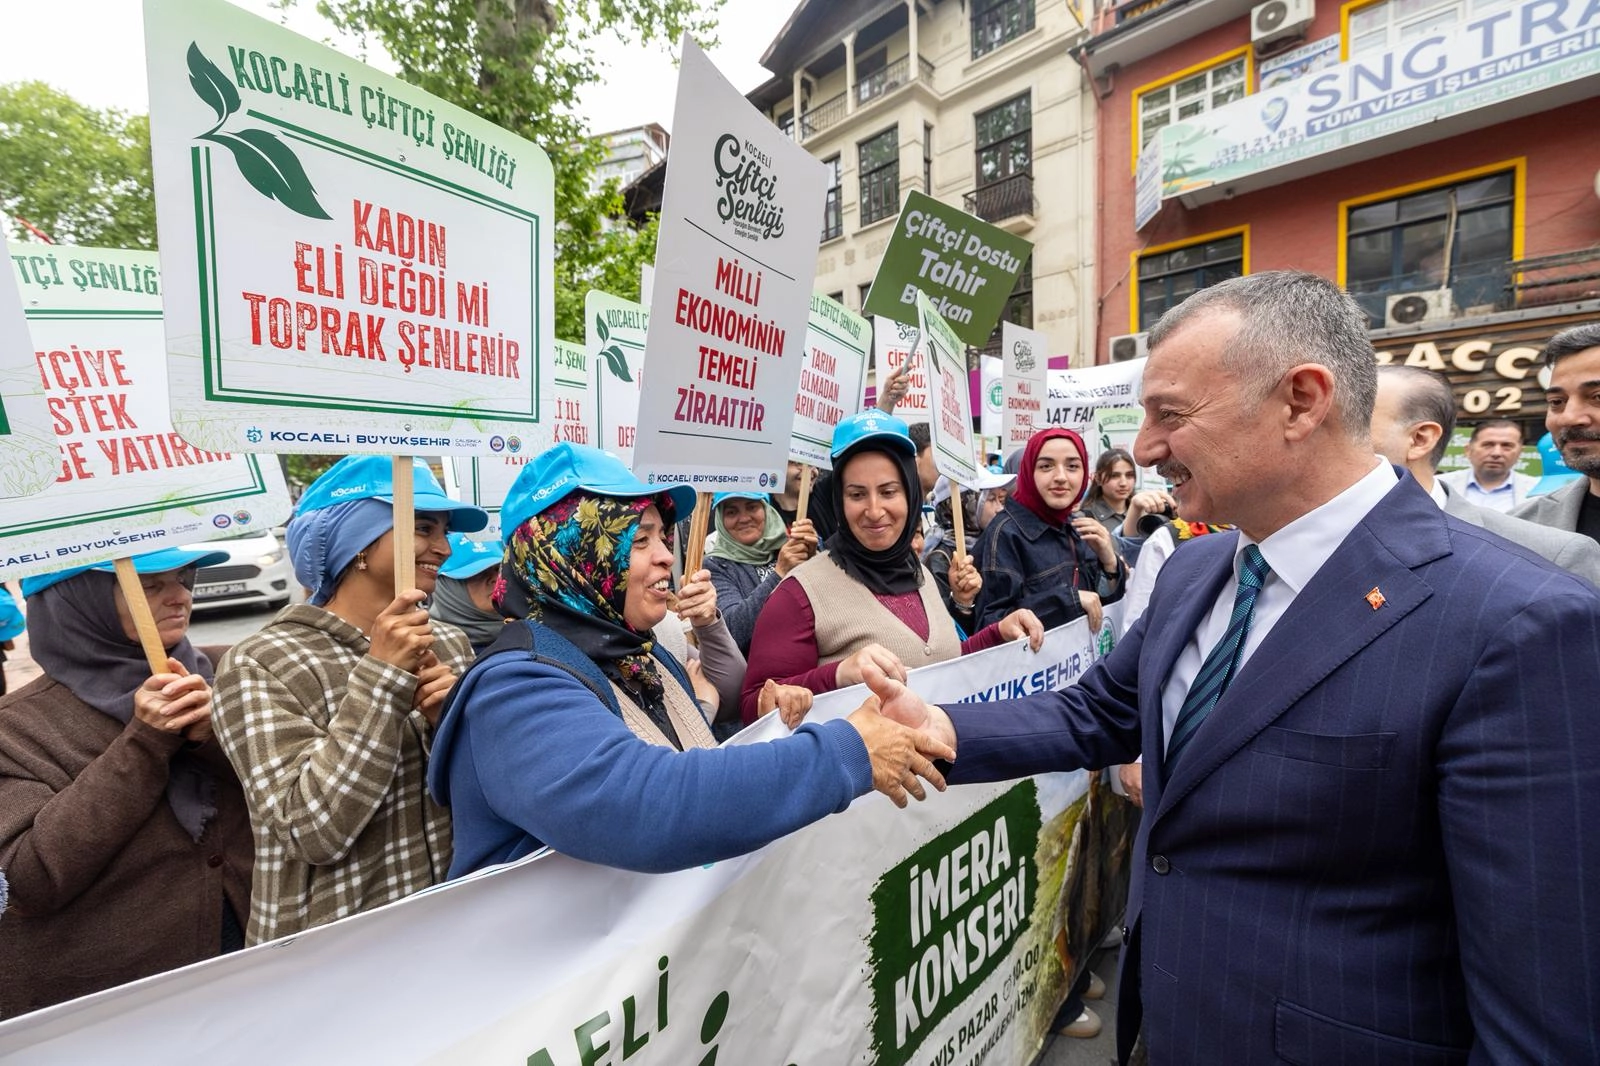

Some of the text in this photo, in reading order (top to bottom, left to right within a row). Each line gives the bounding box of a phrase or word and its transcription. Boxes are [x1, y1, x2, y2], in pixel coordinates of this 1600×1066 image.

[1307, 37, 1447, 112] SNG
[1312, 34, 1600, 131] TÜM VİZE İŞLEMLERİ
[228, 45, 516, 190] KOCAELİ ÇİFTÇİ ŞENLİĞİ
[714, 133, 777, 200] Çiftçi
[744, 139, 772, 169] KOCAELİ
[353, 199, 446, 269] KADIN
[717, 180, 785, 240] Şenliği
[905, 210, 1021, 274] Çiftçi Dostu
[12, 254, 162, 296] TÇİ ŞENLİĞ
[293, 241, 488, 328] ELİ DEĞDİ Mİ
[715, 257, 762, 307] MİLLİ
[918, 248, 987, 297] Tahir
[606, 309, 640, 330] KOCAELİ
[675, 287, 785, 358] EKONOMİNİN
[901, 283, 973, 325] Bkan
[242, 291, 520, 379] TOPRAK ŞENLENİR
[698, 345, 758, 391] TEMELİ
[801, 369, 840, 403] OLMADAN
[811, 347, 837, 377] TARIM
[1376, 340, 1554, 390] ACC
[47, 394, 138, 436] STEK
[564, 422, 588, 444] SIĞI
[565, 398, 580, 421] İLİ
[674, 384, 765, 432] ZİRAATTİR
[97, 433, 232, 476] YATIR
[909, 815, 1012, 948] İMERA
[894, 855, 1026, 1050] KONSERİ
[958, 993, 998, 1053] PAZAR
